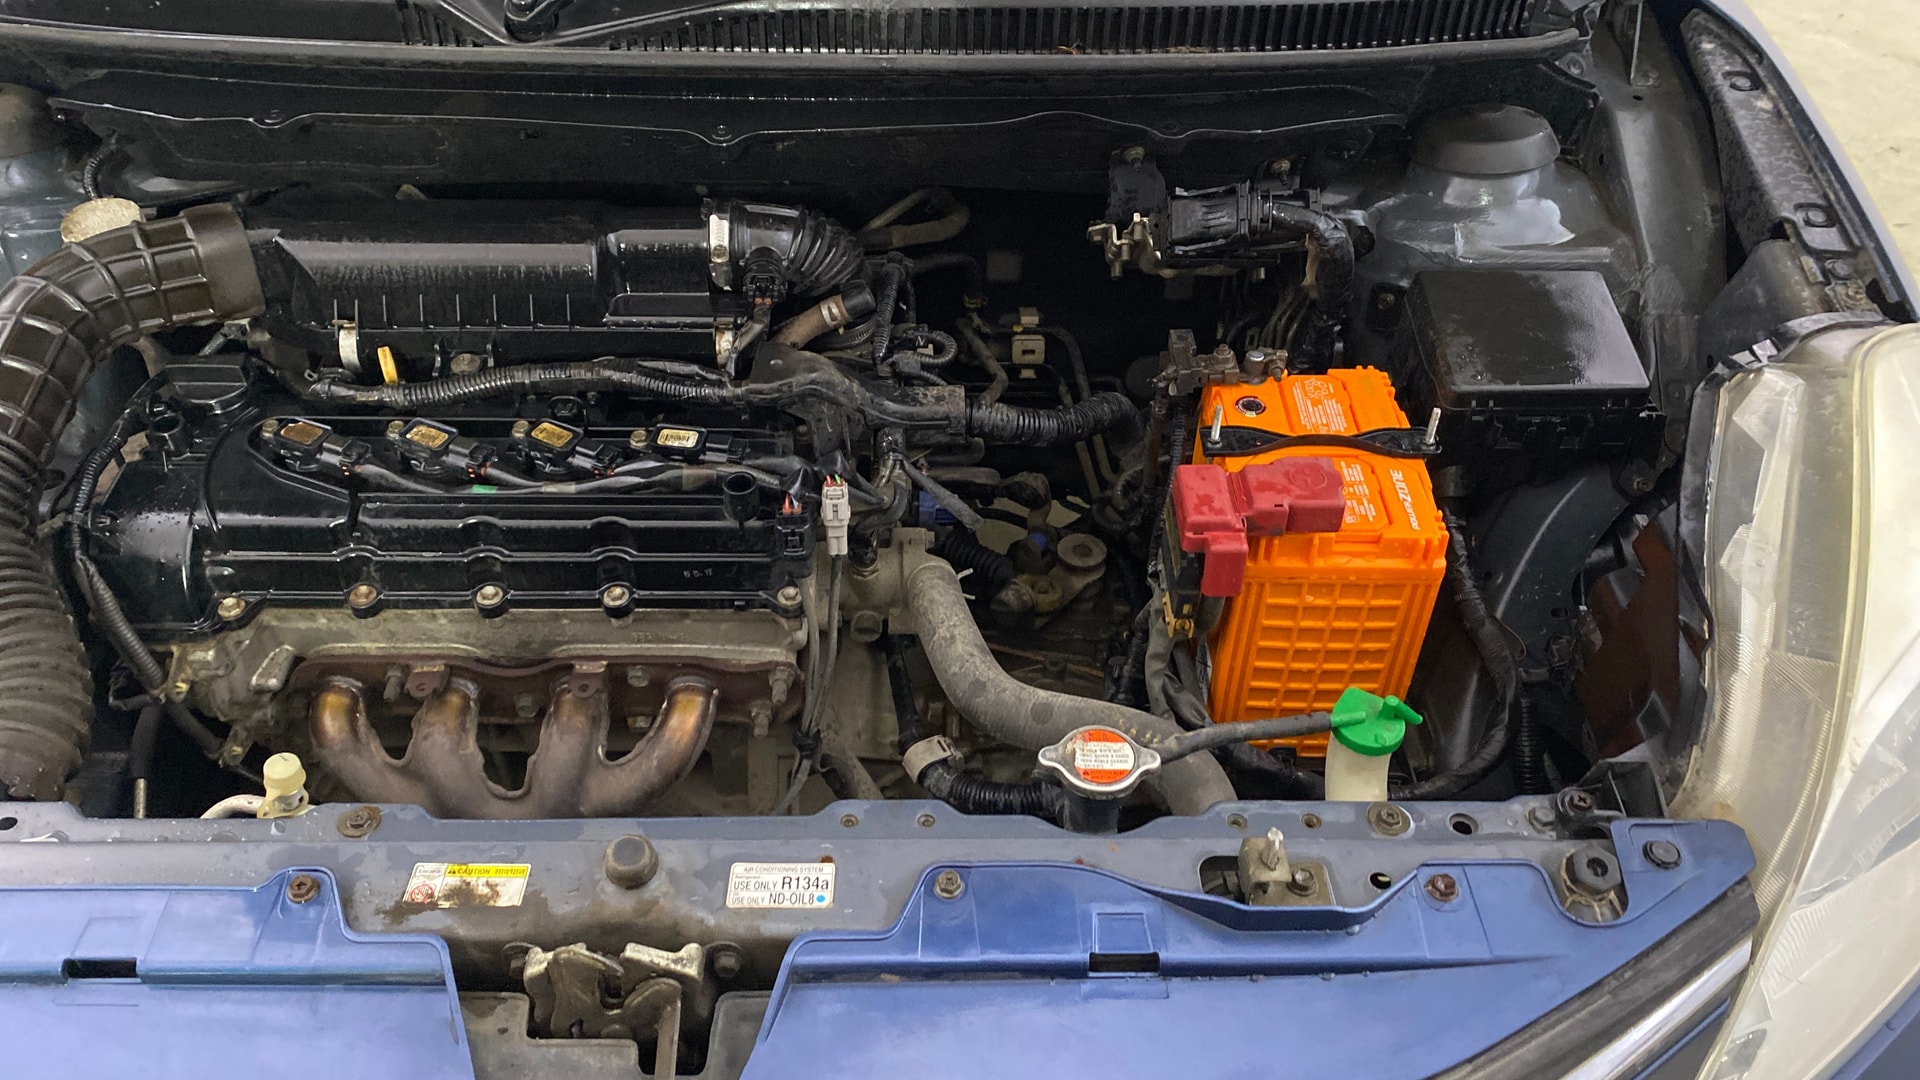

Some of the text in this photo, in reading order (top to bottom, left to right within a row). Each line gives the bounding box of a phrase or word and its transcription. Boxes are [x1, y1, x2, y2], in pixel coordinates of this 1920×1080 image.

[457, 867, 490, 875] CAUTION
[733, 876, 829, 890] USE ONLY R134a
[732, 892, 815, 905] USE ONLY ND-OIL8
